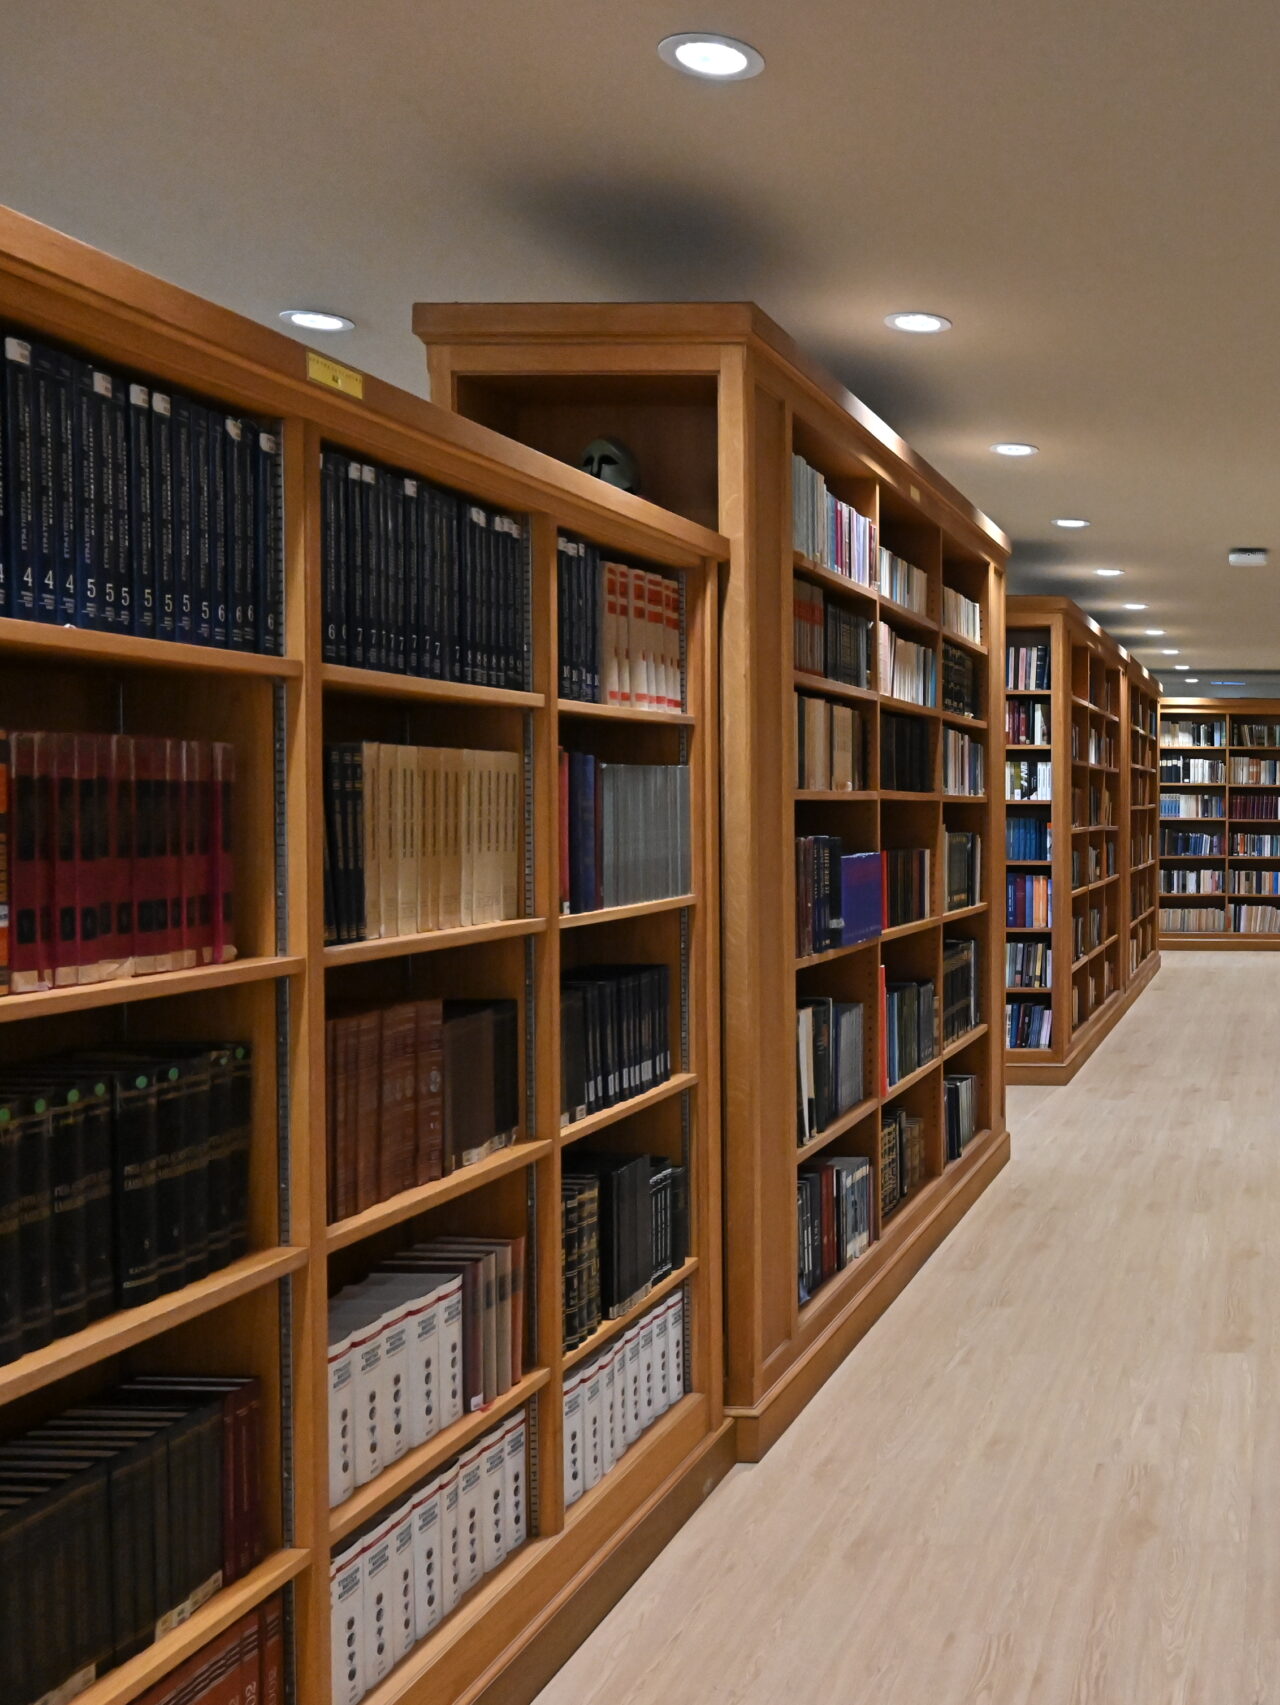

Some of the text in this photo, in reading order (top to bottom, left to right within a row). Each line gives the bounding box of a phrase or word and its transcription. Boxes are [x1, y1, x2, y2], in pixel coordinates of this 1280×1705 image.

[24, 568, 32, 586] 4
[44, 570, 54, 589] 4
[66, 574, 74, 593] 4
[87, 579, 96, 598] 5
[106, 583, 114, 602] 5
[122, 587, 130, 606] 5
[144, 589, 152, 607] 5
[165, 595, 172, 612] 5
[183, 595, 190, 612] 5
[202, 602, 209, 619] 5
[218, 604, 225, 622] 6
[236, 606, 242, 623] 6
[248, 605, 254, 622] 6
[268, 614, 274, 630] 6
[328, 624, 335, 639] 6
